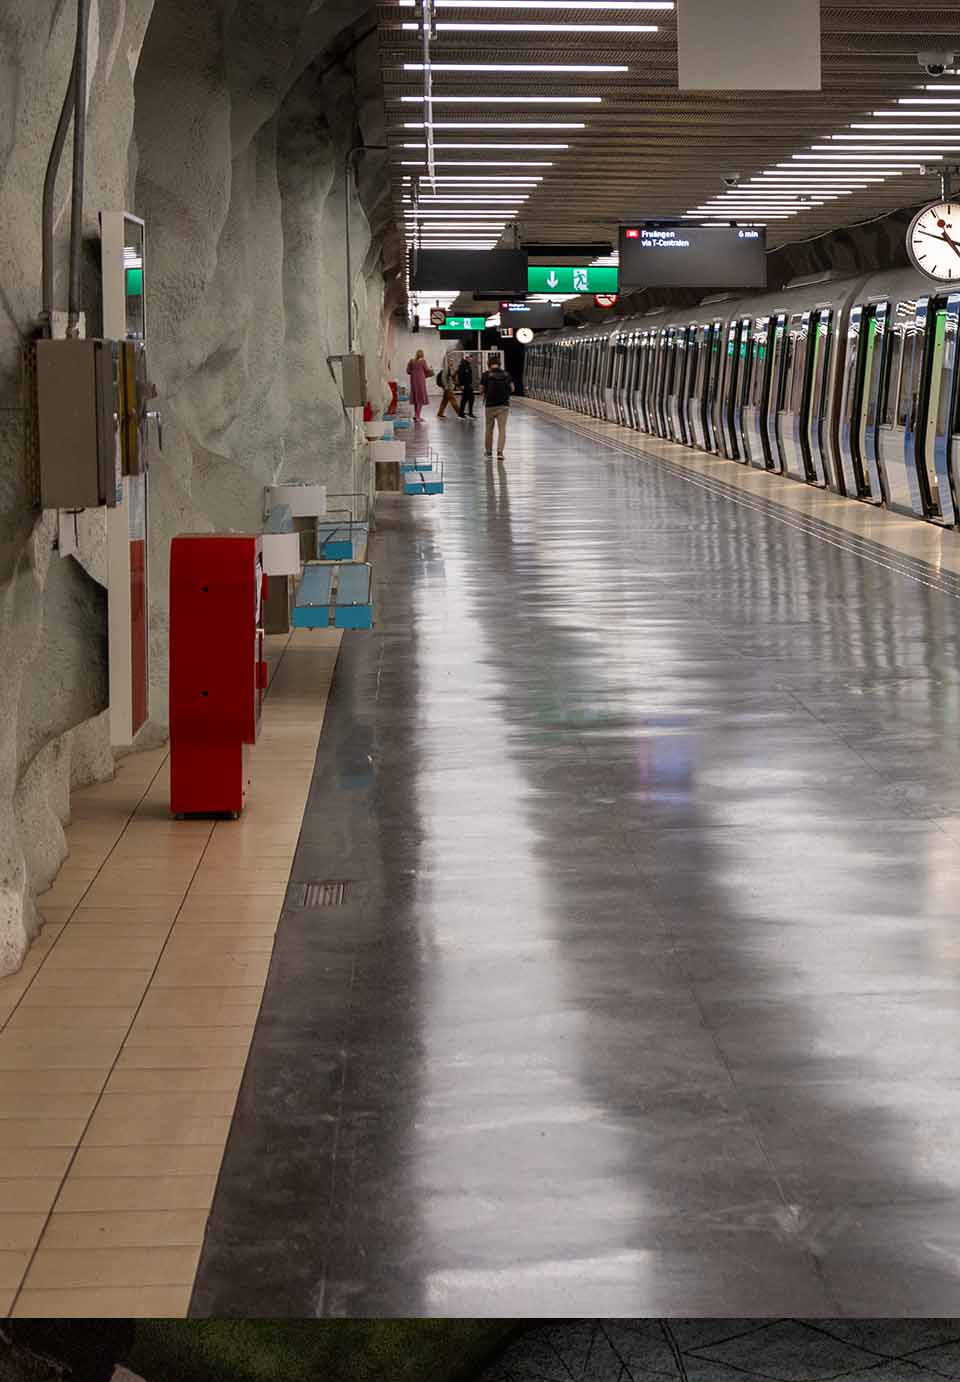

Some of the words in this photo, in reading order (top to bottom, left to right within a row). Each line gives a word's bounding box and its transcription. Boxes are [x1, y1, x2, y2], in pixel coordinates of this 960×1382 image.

[744, 230, 759, 238] min
[641, 239, 652, 247] via
[652, 239, 690, 247] T-Centralen
